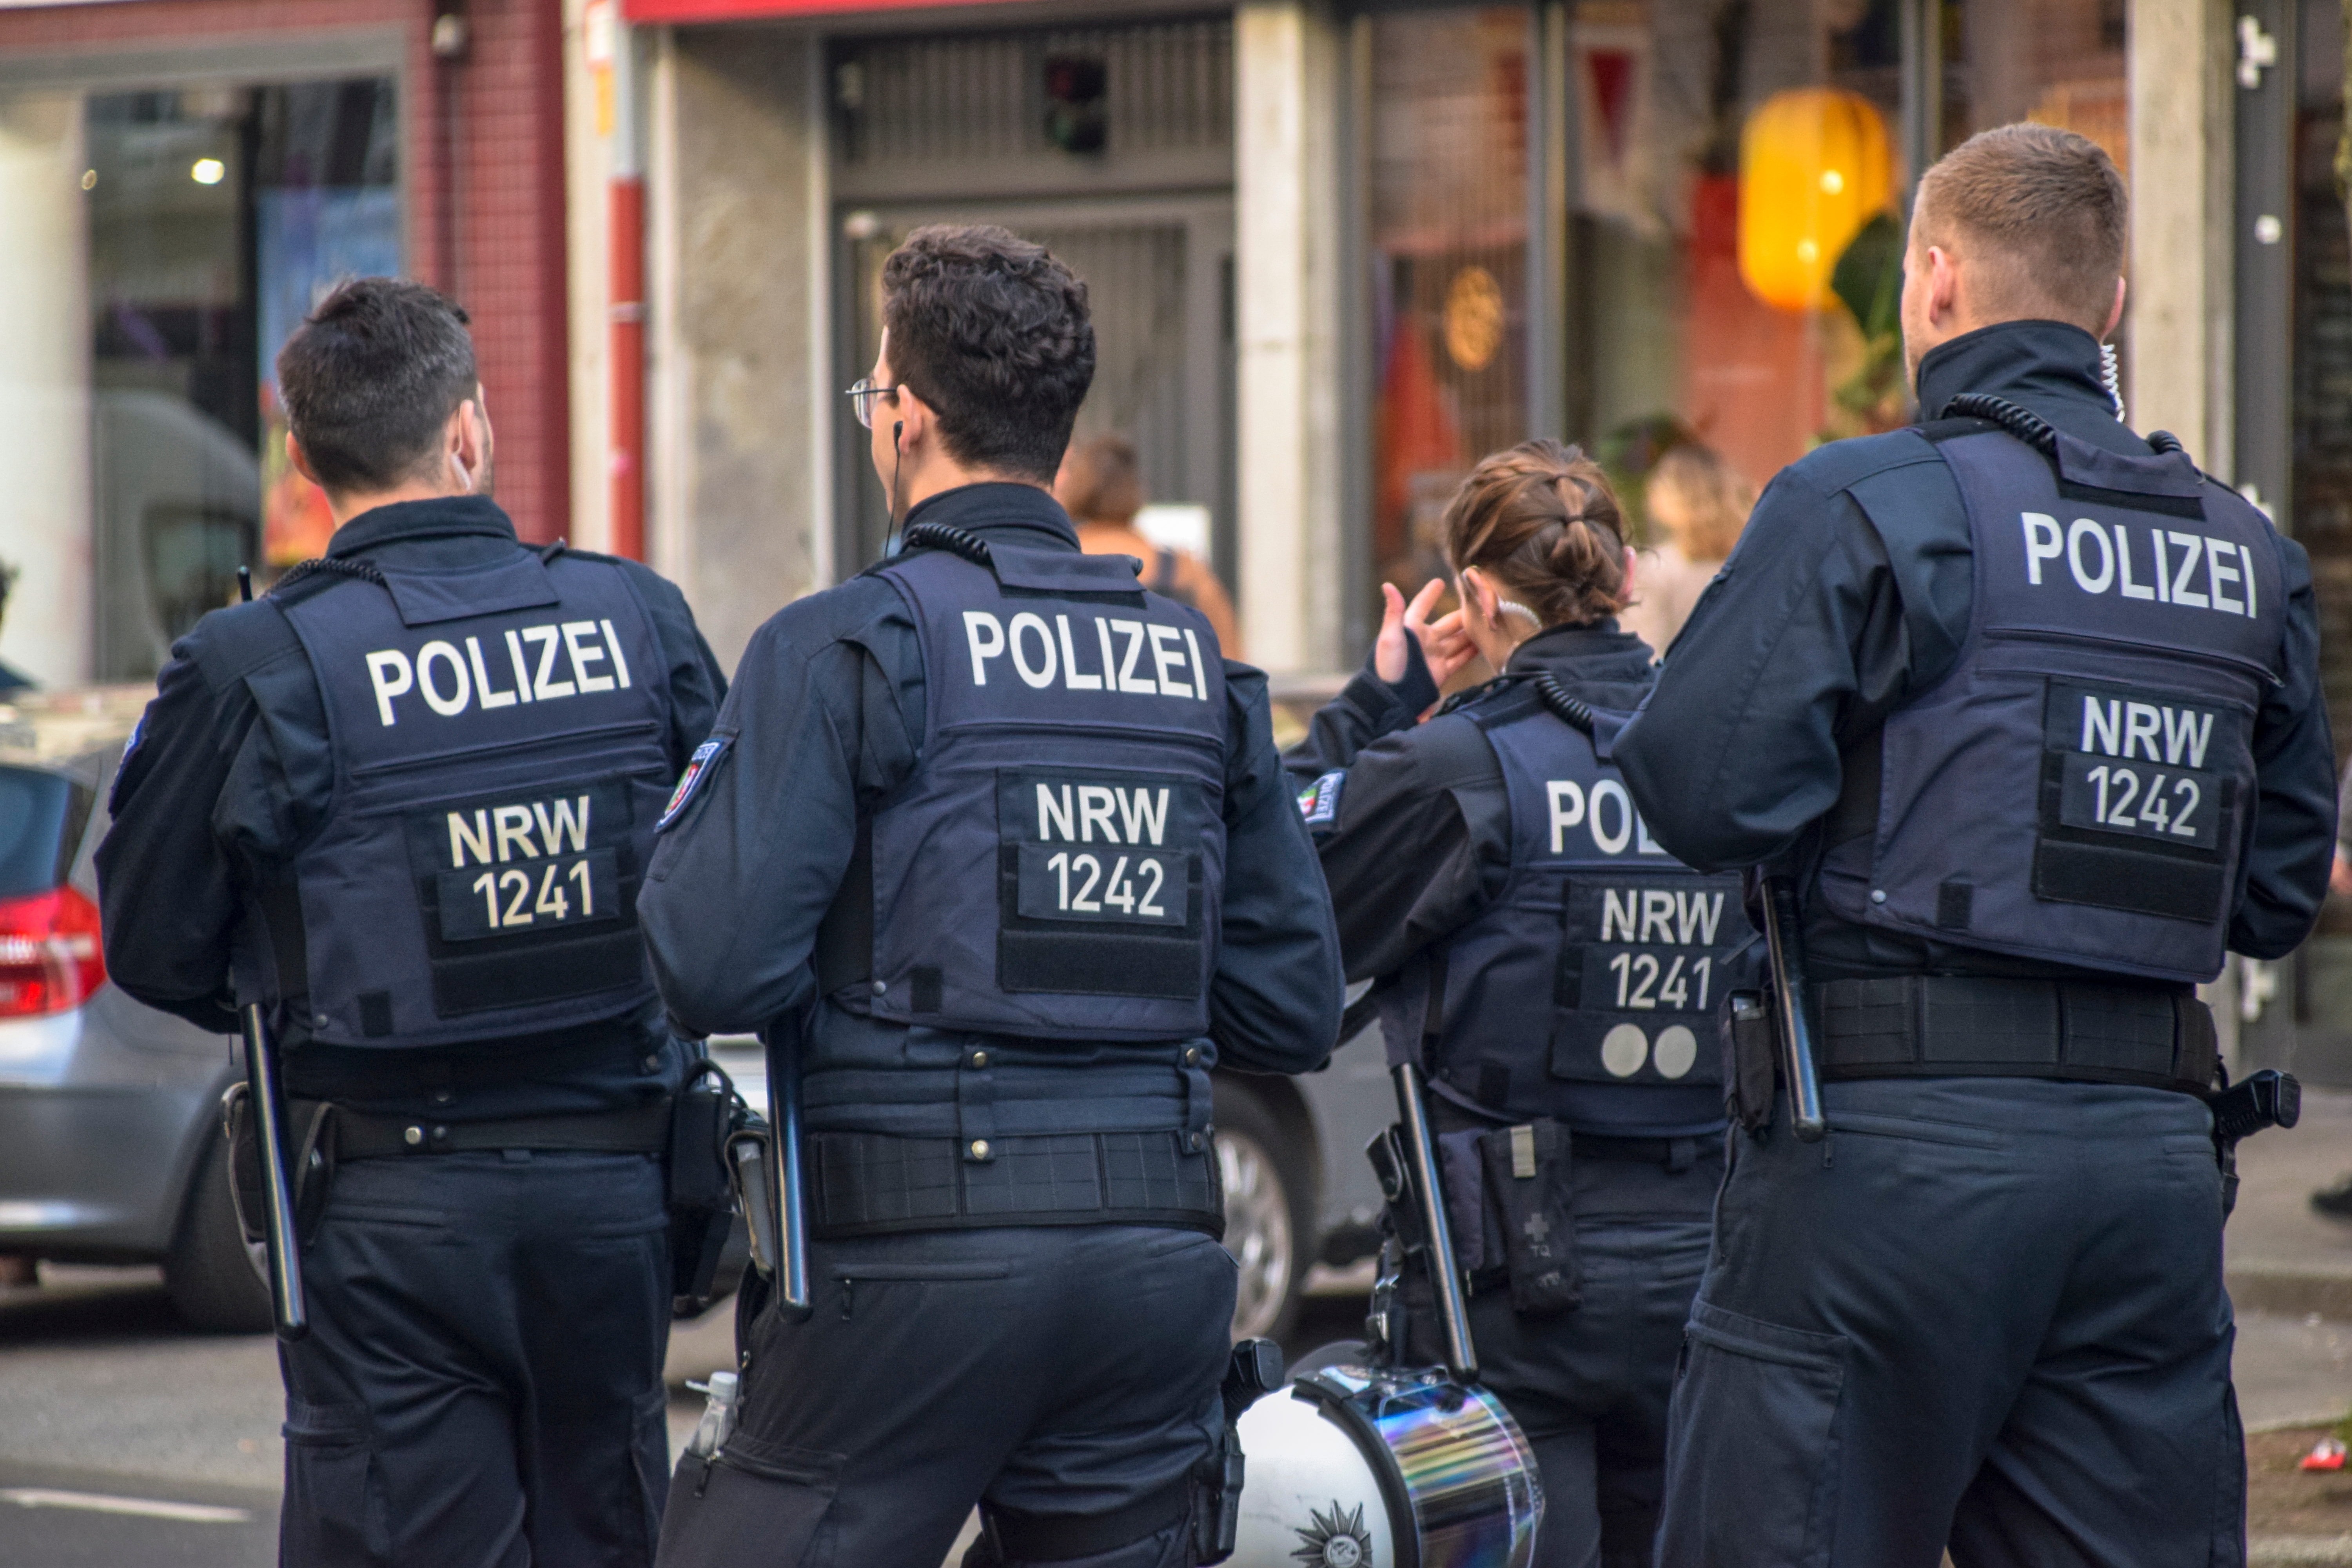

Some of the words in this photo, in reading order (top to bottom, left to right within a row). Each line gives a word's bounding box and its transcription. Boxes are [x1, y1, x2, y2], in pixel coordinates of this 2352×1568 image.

[2021, 512, 2256, 619] POLIZEI
[365, 619, 632, 726] POLIZEI
[962, 610, 1208, 701] POLIZEI
[2082, 696, 2213, 768] NRW
[447, 795, 589, 867] NRW
[1036, 783, 1170, 846] NRW
[2088, 766, 2199, 836] 1242
[473, 860, 591, 927] 1241
[1047, 852, 1164, 916] 1242
[1602, 889, 1724, 944] NRW
[1611, 953, 1711, 1009] 1241
